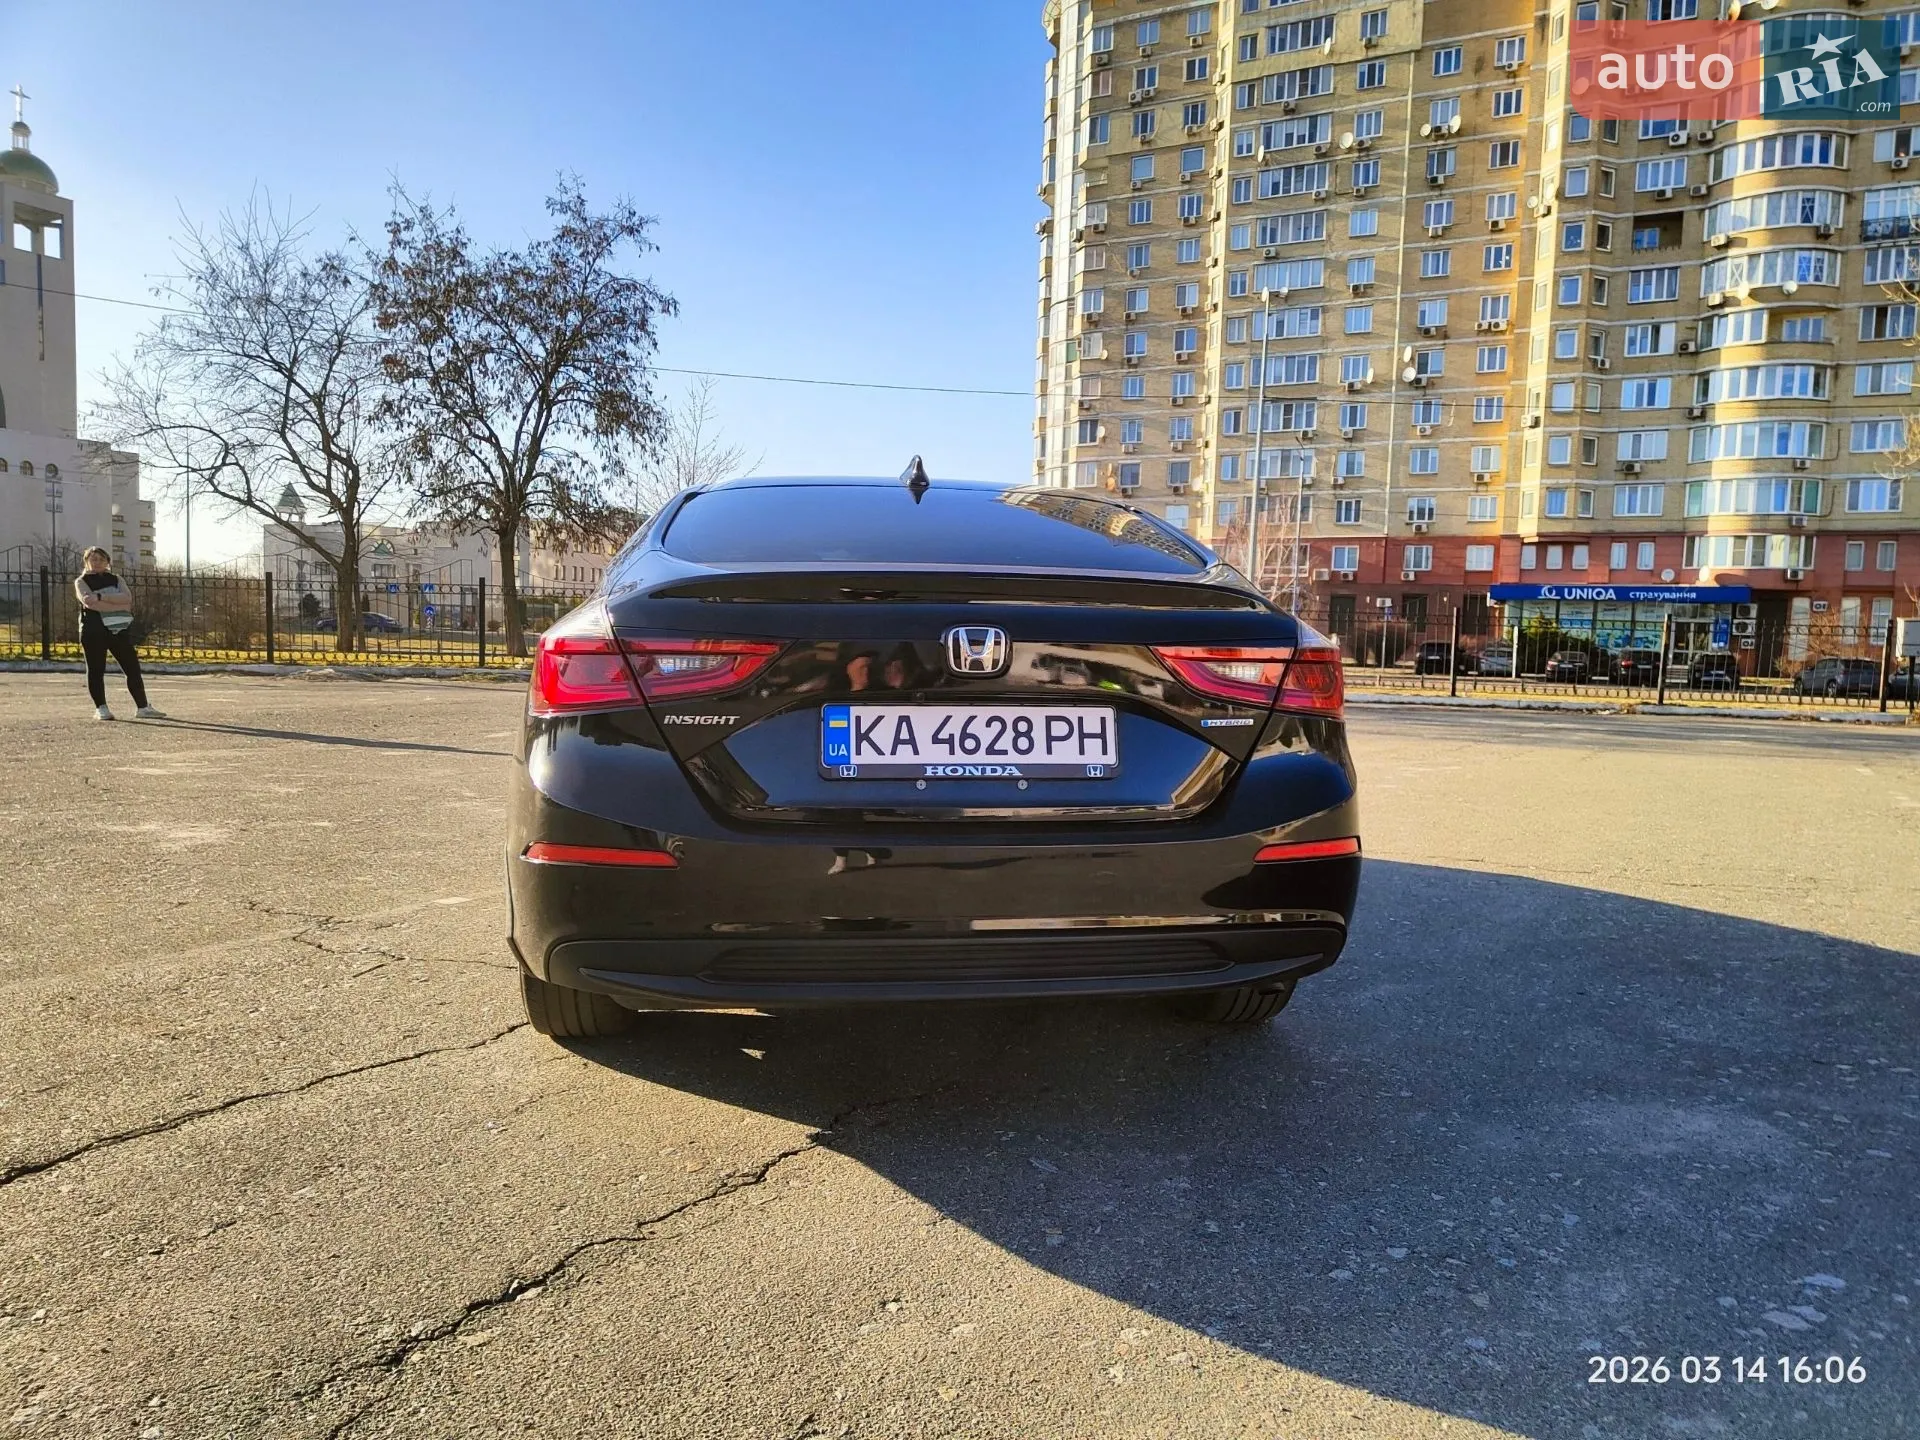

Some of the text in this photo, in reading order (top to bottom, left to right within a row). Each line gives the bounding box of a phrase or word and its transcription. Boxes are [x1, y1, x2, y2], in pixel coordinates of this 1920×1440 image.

[1564, 587, 1617, 600] UNIQA
[1629, 591, 1697, 600] страхування
[854, 714, 1108, 756] KA 4628 PH
[828, 744, 848, 757] UA
[923, 766, 1023, 776] HONDA
